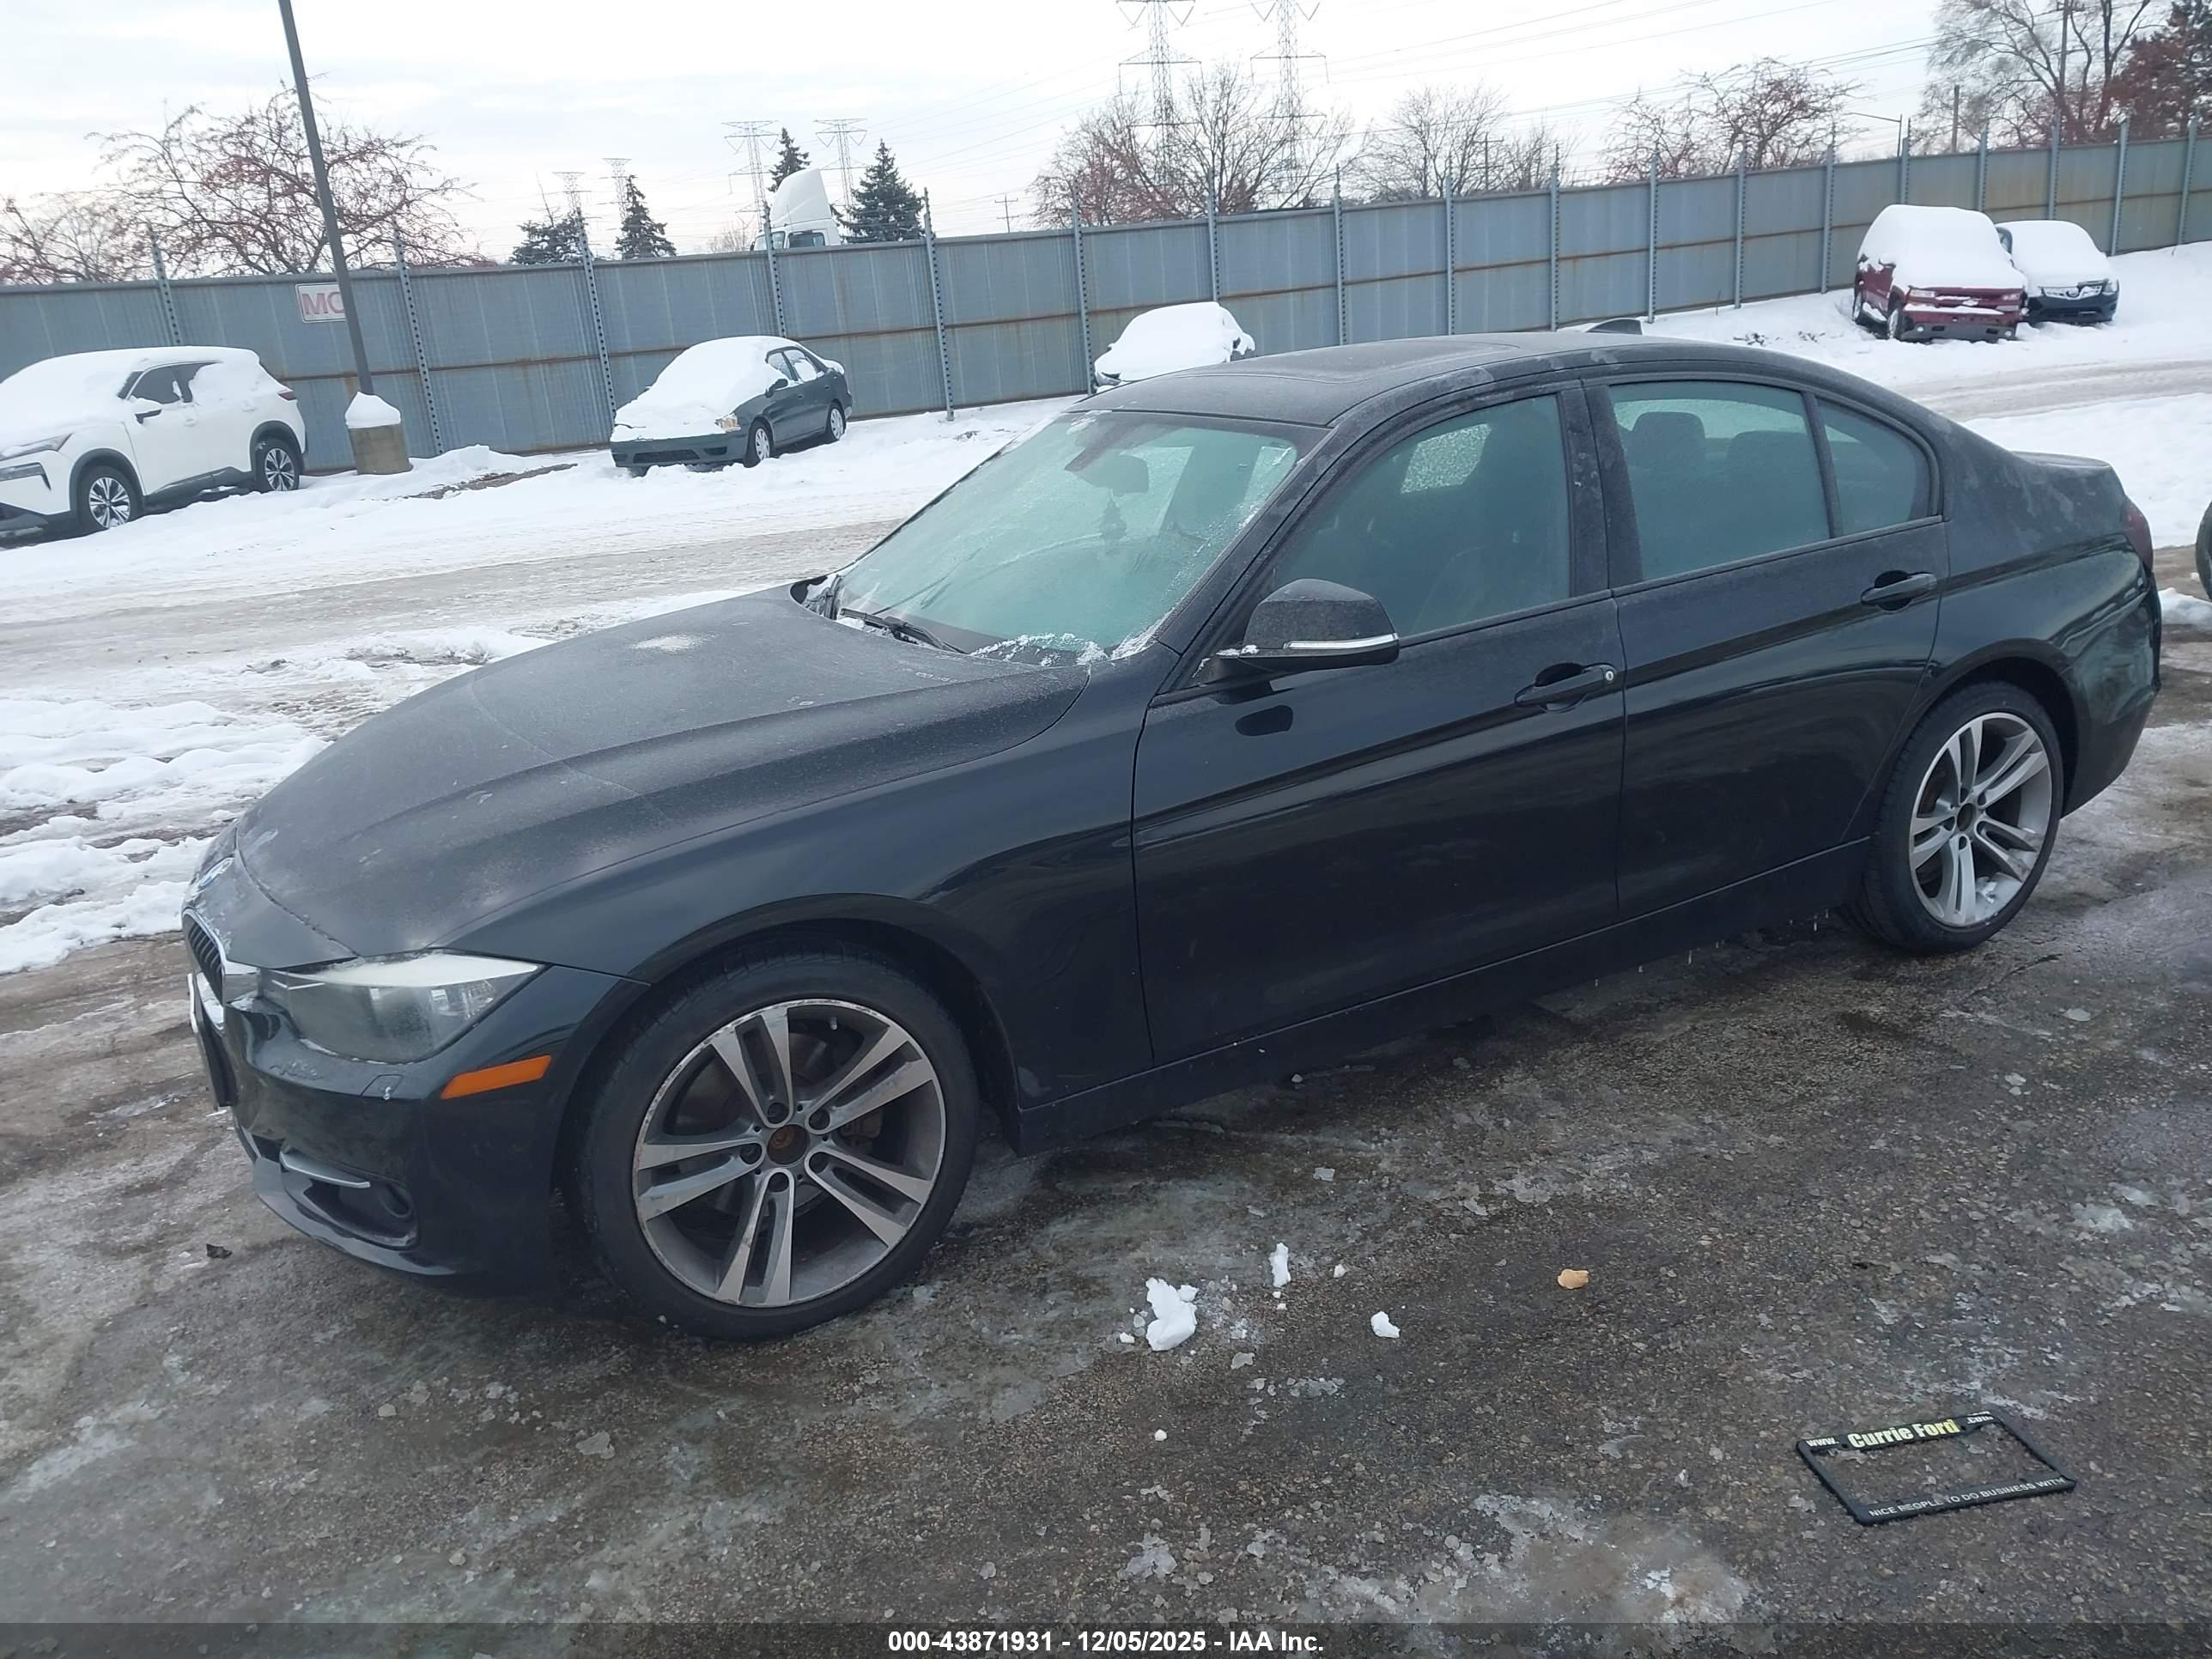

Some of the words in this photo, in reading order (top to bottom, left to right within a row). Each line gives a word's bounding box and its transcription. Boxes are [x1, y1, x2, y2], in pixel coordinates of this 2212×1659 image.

[1806, 1437, 1839, 1447] www.
[1847, 1426, 1914, 1448] Currie
[1911, 1419, 1961, 1437] Ford
[1869, 1506, 1898, 1517] NICE
[1962, 1492, 1979, 1501] DO
[1981, 1483, 2036, 1498] BUSINESS
[2036, 1477, 2066, 1488] WITH
